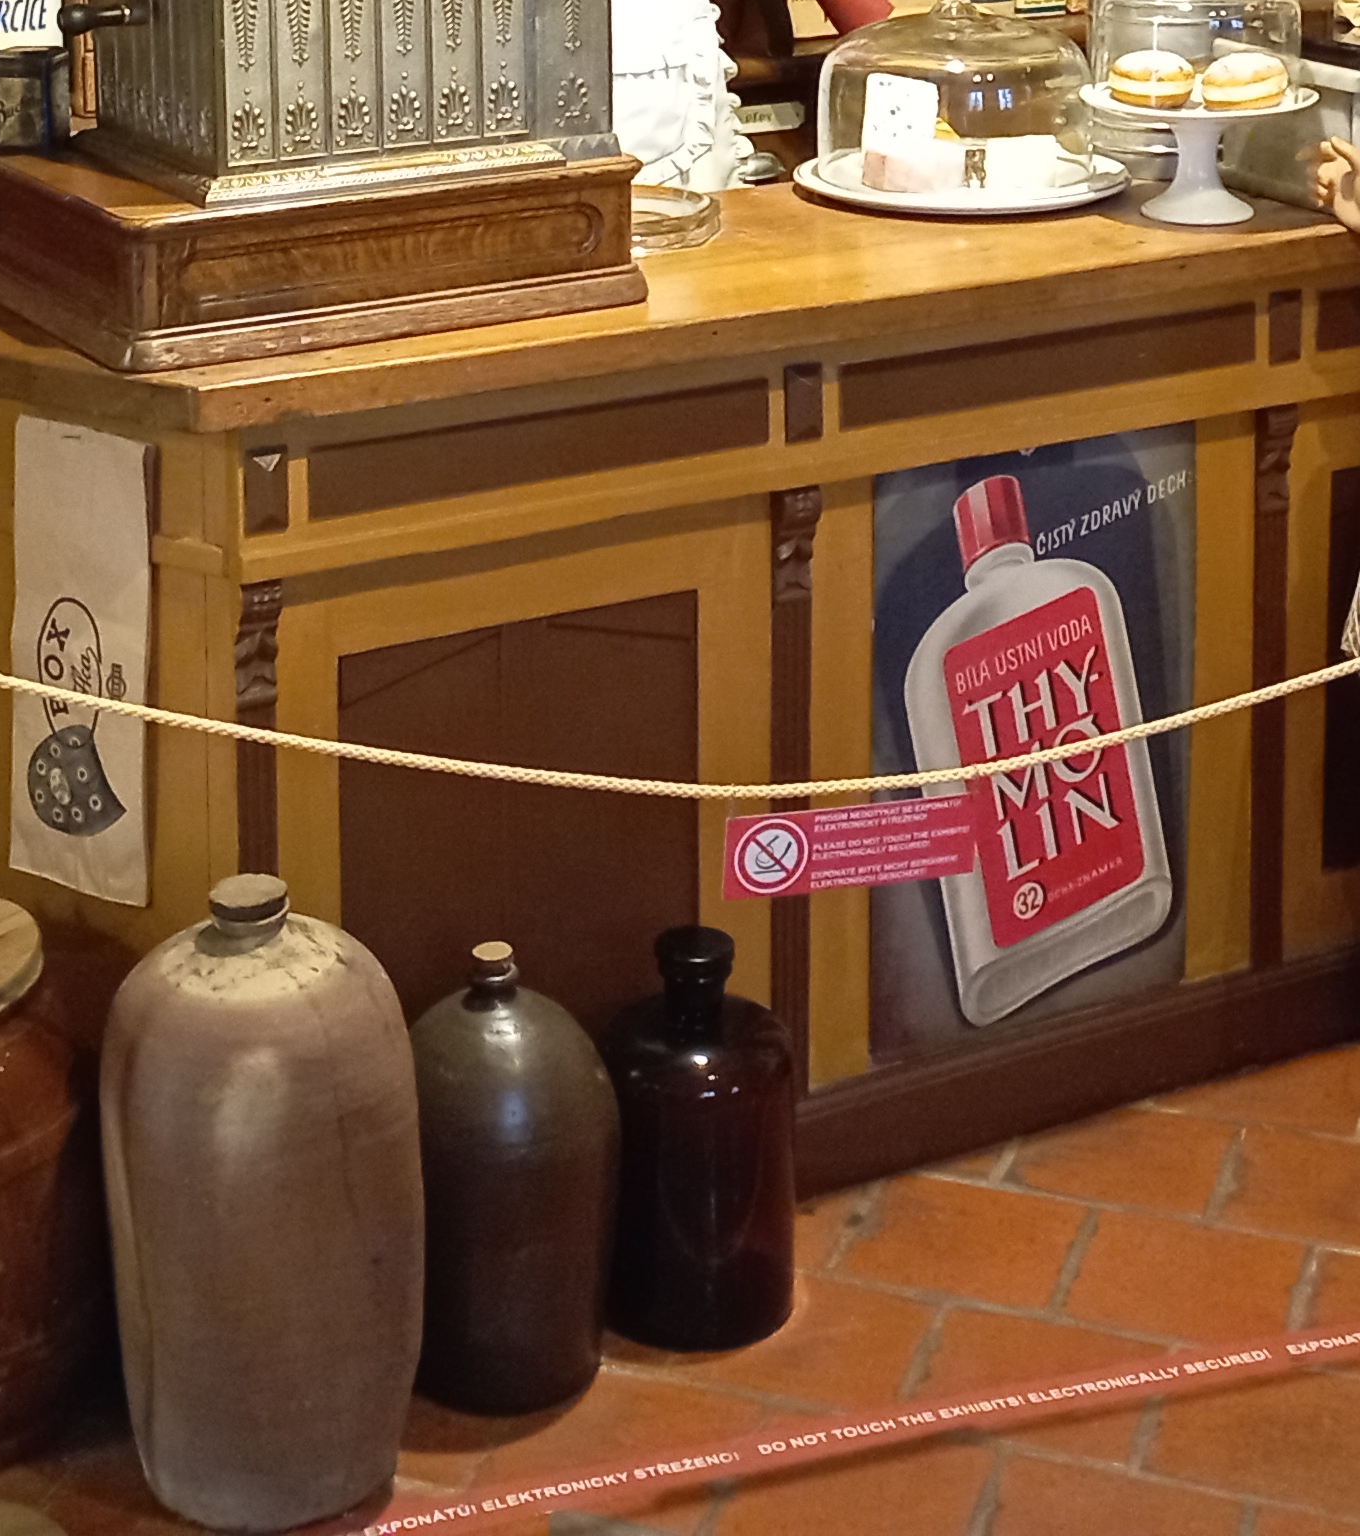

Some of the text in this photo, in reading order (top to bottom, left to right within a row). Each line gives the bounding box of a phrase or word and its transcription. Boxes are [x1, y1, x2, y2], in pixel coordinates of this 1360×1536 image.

[1080, 487, 1142, 537] ZDRAVÝ
[1147, 468, 1187, 505] DECH
[1047, 613, 1093, 652] VODA
[862, 836, 881, 846] NOT
[883, 834, 912, 844] TOUCH
[913, 831, 929, 839] THE
[996, 772, 1121, 881] LIN
[1016, 885, 1041, 913] 32
[481, 1471, 629, 1513] ELEKTRONICKY
[758, 1440, 786, 1456] DO
[790, 1431, 828, 1449] NOT
[831, 1418, 896, 1441] TOUCH
[898, 1411, 936, 1429] THE
[939, 1394, 1026, 1421] EXHIBITS!
[1027, 1366, 1179, 1405] ELECTRONICALLY
[1183, 1349, 1272, 1377] SECURED!
